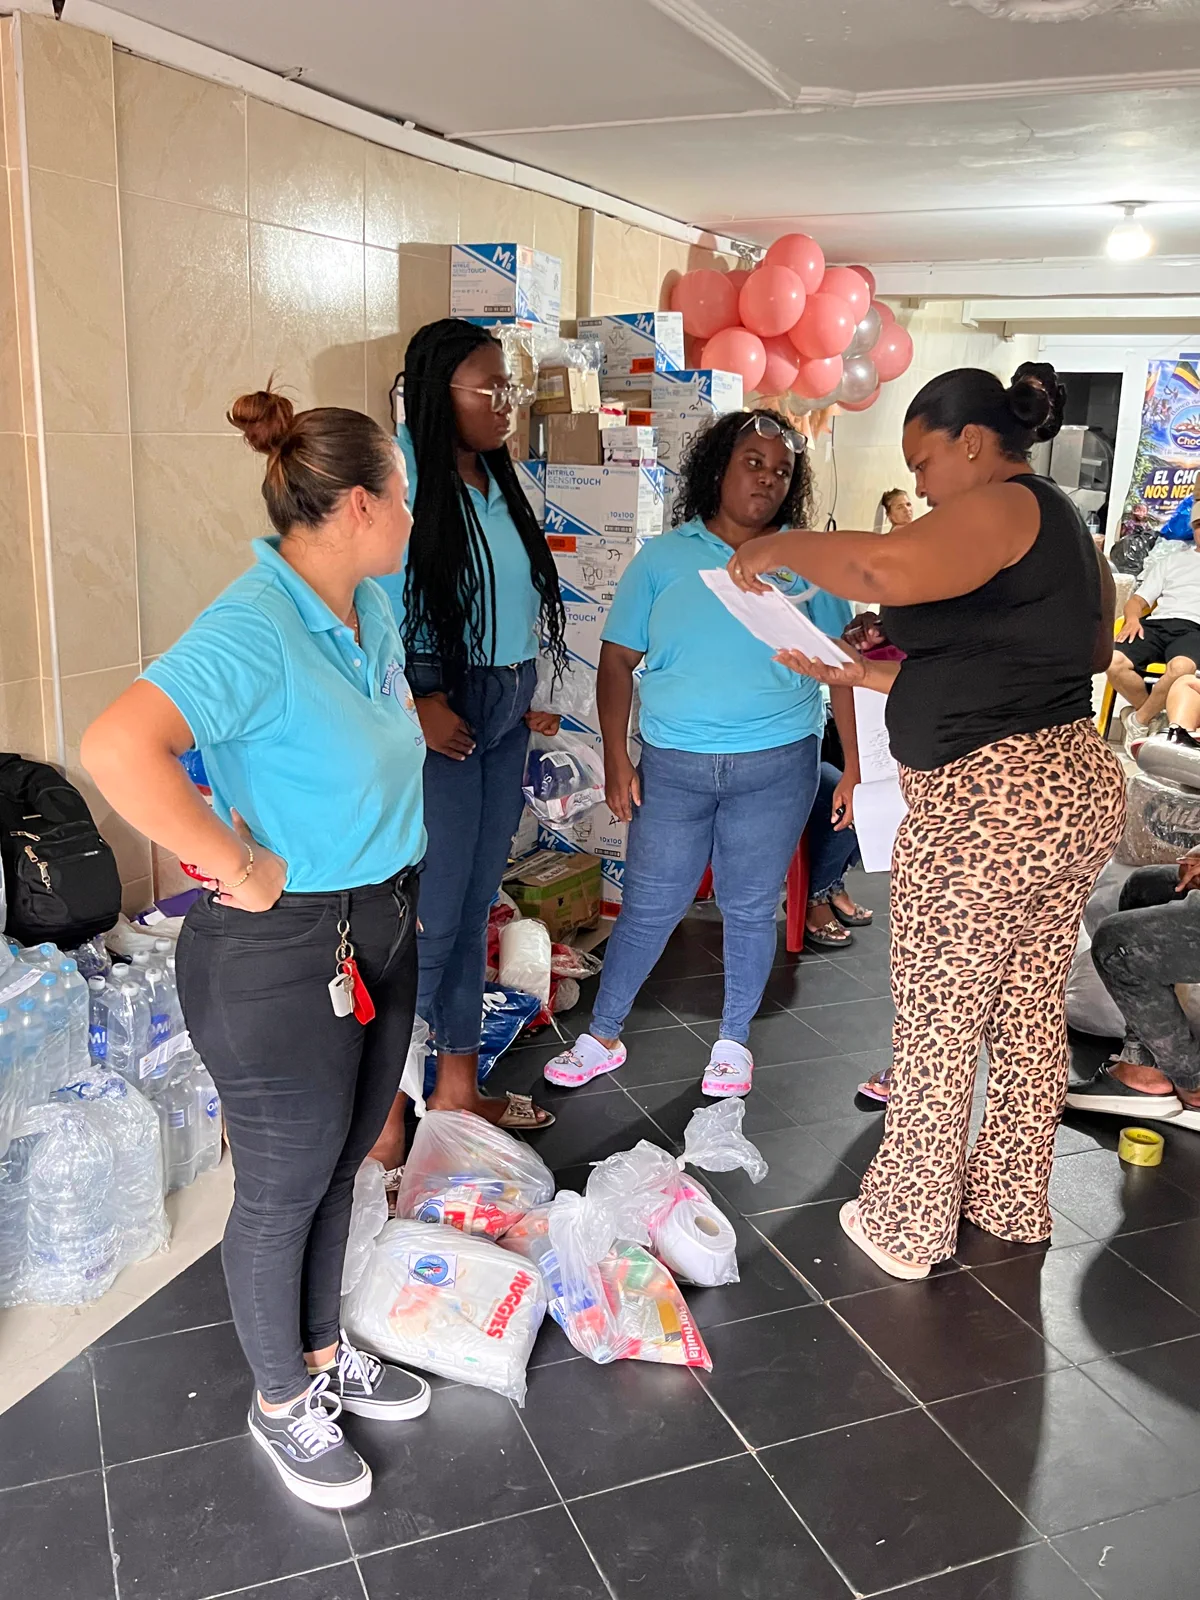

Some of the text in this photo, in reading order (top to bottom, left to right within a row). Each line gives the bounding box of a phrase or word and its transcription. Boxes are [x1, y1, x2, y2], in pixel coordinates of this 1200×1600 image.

[1177, 436, 1200, 446] Choc
[547, 469, 575, 477] NITRILO
[1153, 470, 1170, 485] EL
[548, 477, 601, 486] SENSITOUCH
[1144, 485, 1195, 499] NOS NEC
[568, 613, 597, 622] TOUCH
[599, 836, 623, 845] 10x100
[486, 1269, 536, 1339] HUGGIES
